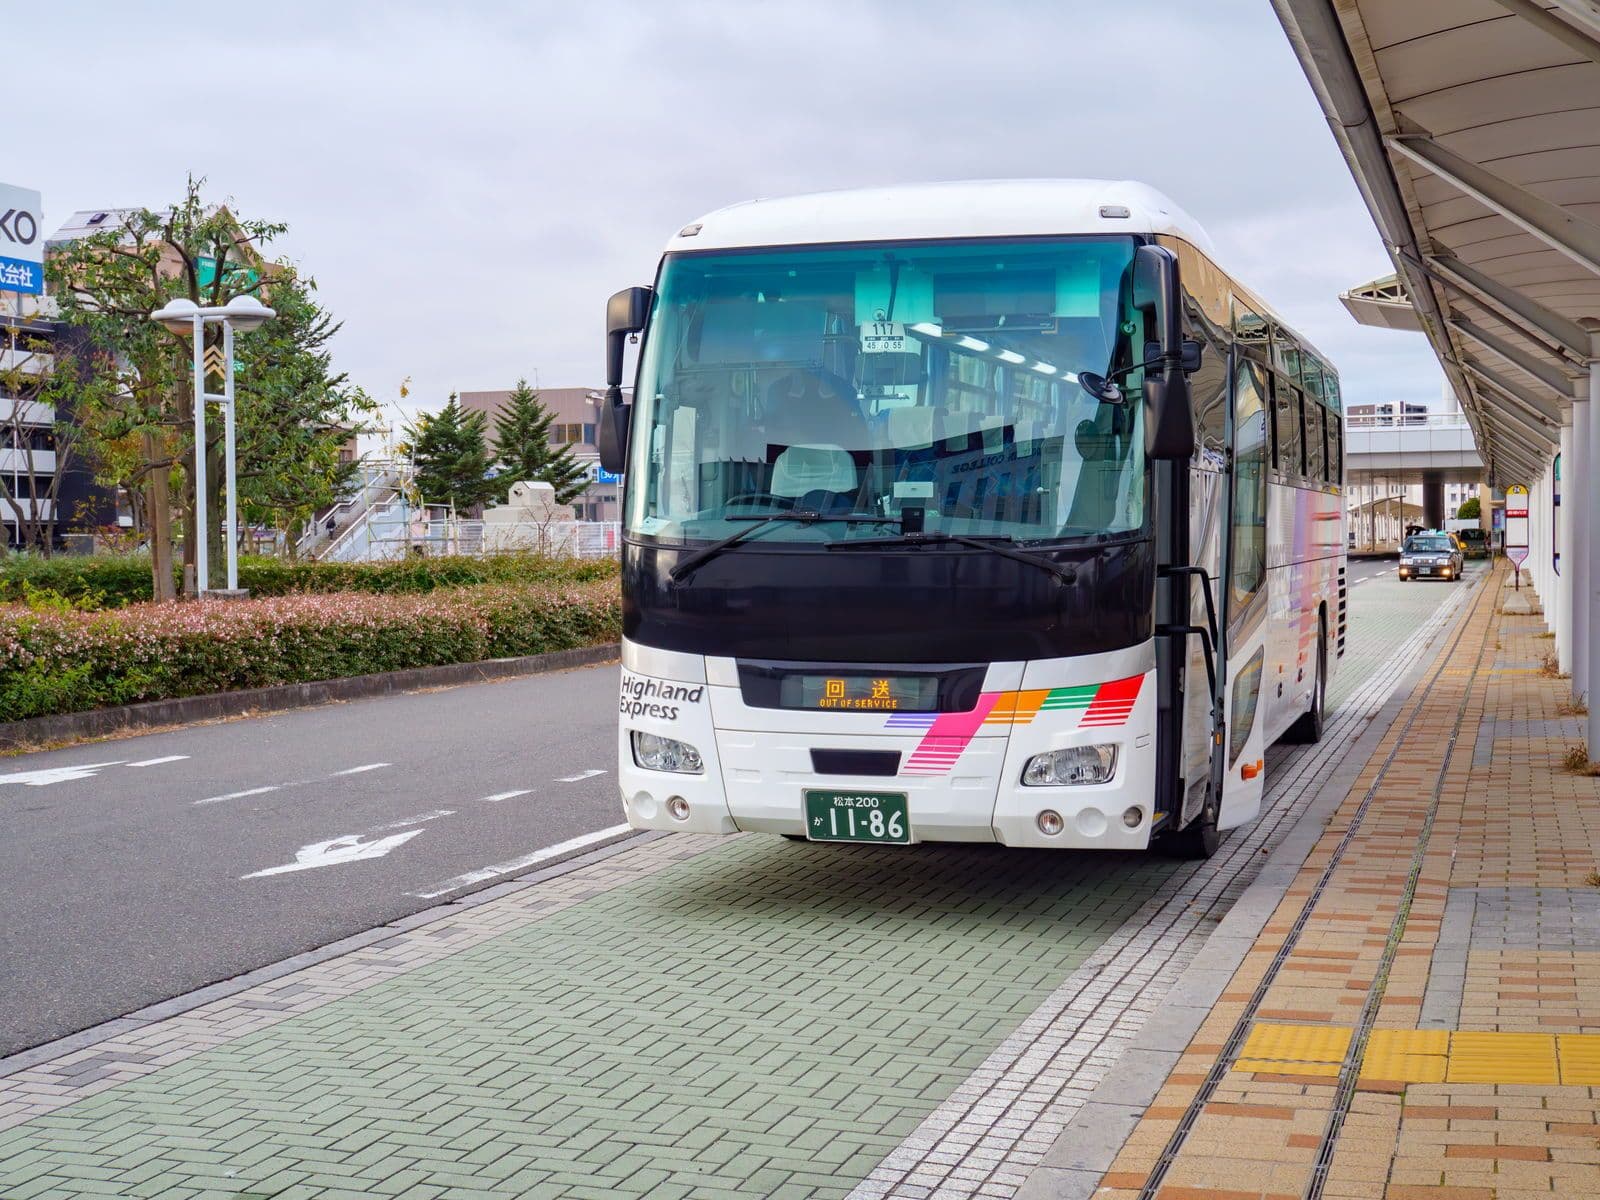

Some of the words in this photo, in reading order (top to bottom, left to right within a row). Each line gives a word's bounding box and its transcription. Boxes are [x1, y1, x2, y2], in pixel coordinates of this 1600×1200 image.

[872, 322, 894, 335] 117
[892, 341, 902, 349] 55
[621, 675, 704, 703] Highland
[619, 695, 680, 720] Express
[819, 698, 838, 708] OUT
[840, 699, 853, 708] OF
[854, 699, 897, 709] SERVICE
[813, 816, 824, 826] か
[829, 807, 903, 838] 11-86
